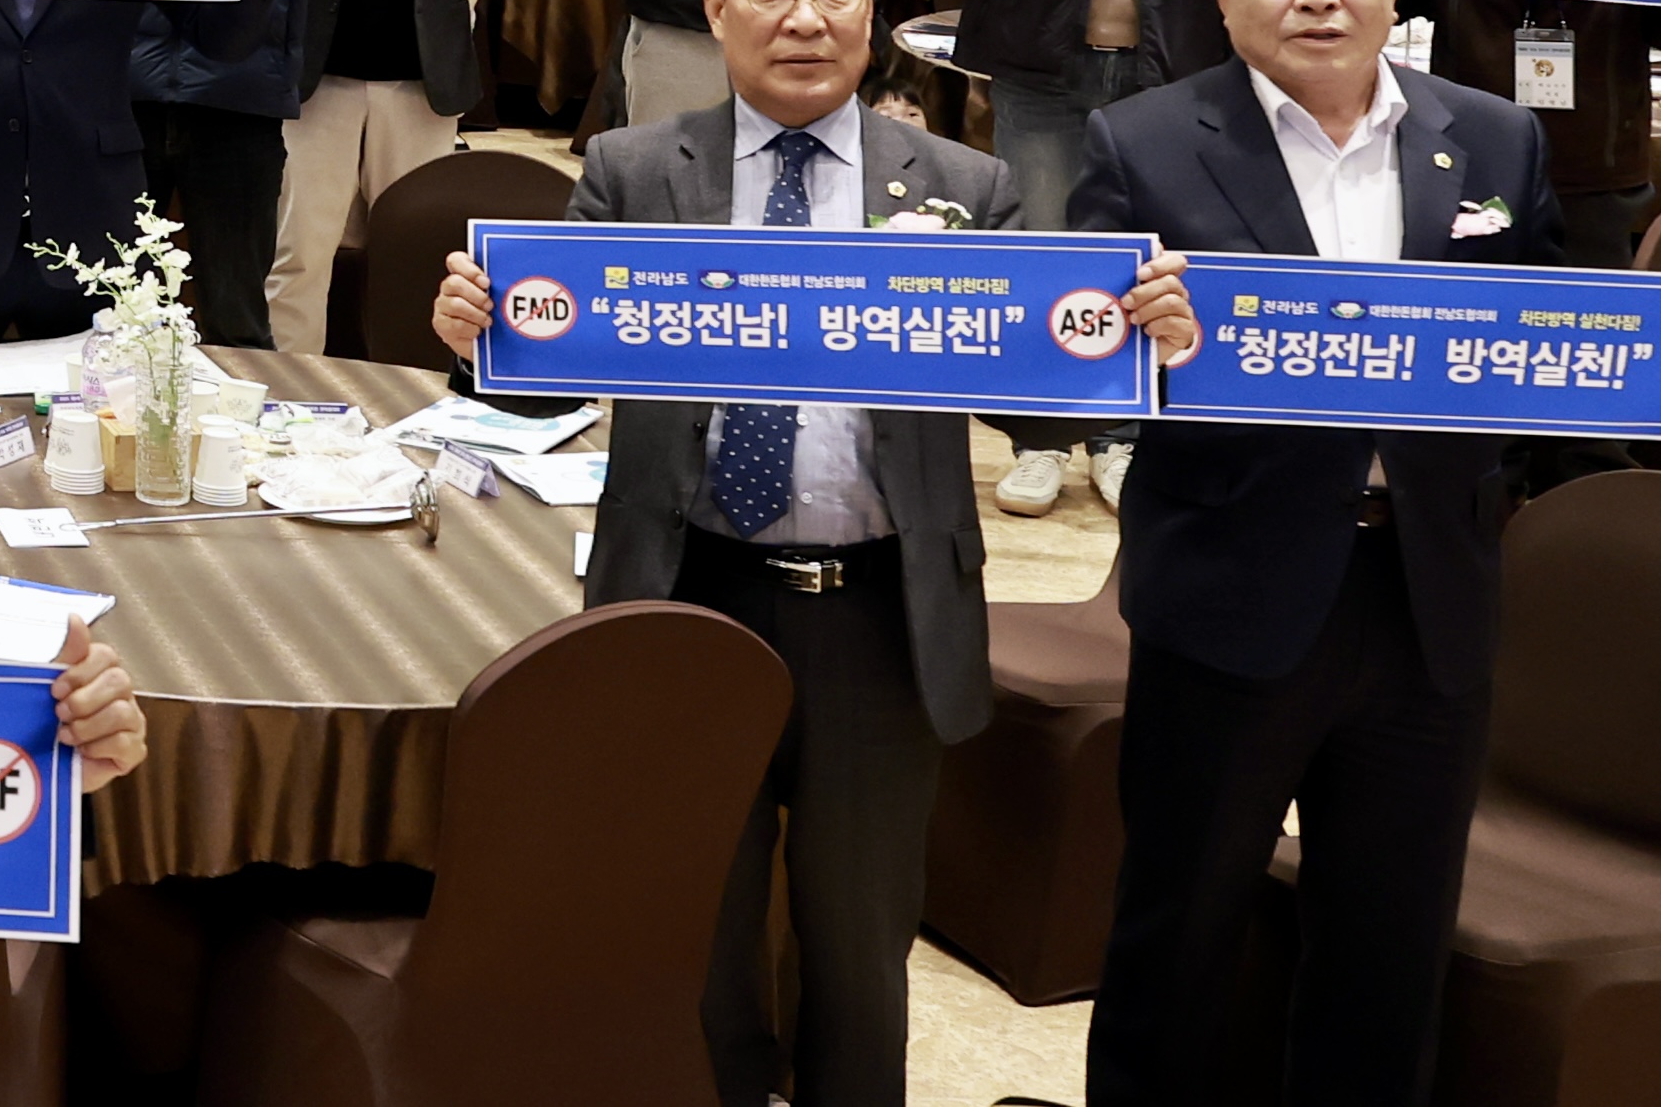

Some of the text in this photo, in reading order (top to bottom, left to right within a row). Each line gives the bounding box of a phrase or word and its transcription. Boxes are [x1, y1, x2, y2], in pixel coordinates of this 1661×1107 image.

[632, 270, 1010, 296] 전라남도 전남도협의회 차단방역 실천다짐!
[513, 296, 569, 320] FMD
[1059, 307, 1114, 337] ASF
[1262, 298, 1642, 332] 전라남도 전남도협의회 차단방역 실천다짐!
